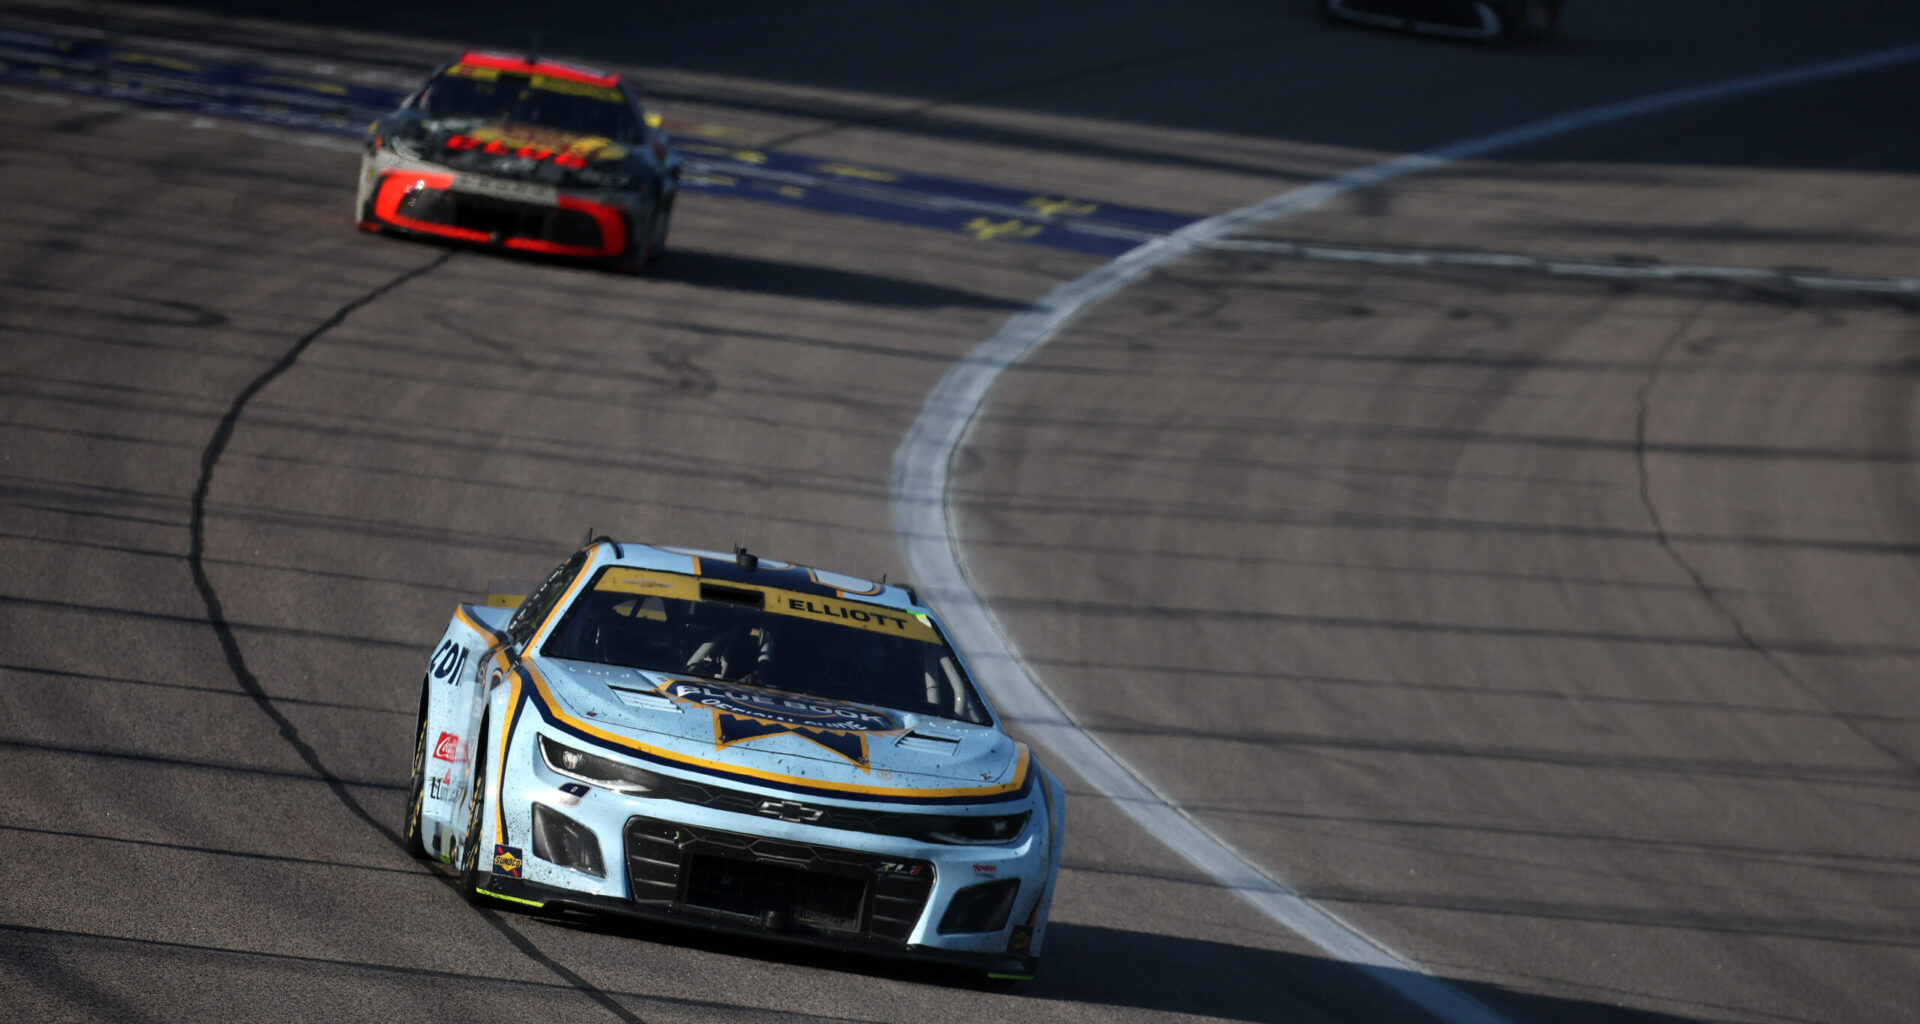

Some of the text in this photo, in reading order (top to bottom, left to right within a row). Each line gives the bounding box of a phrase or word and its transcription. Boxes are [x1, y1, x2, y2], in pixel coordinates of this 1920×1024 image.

[788, 598, 909, 630] ELLIOTT
[676, 684, 771, 705] BLUE
[783, 699, 882, 725] BOOK
[495, 856, 521, 868] SUNOCO
